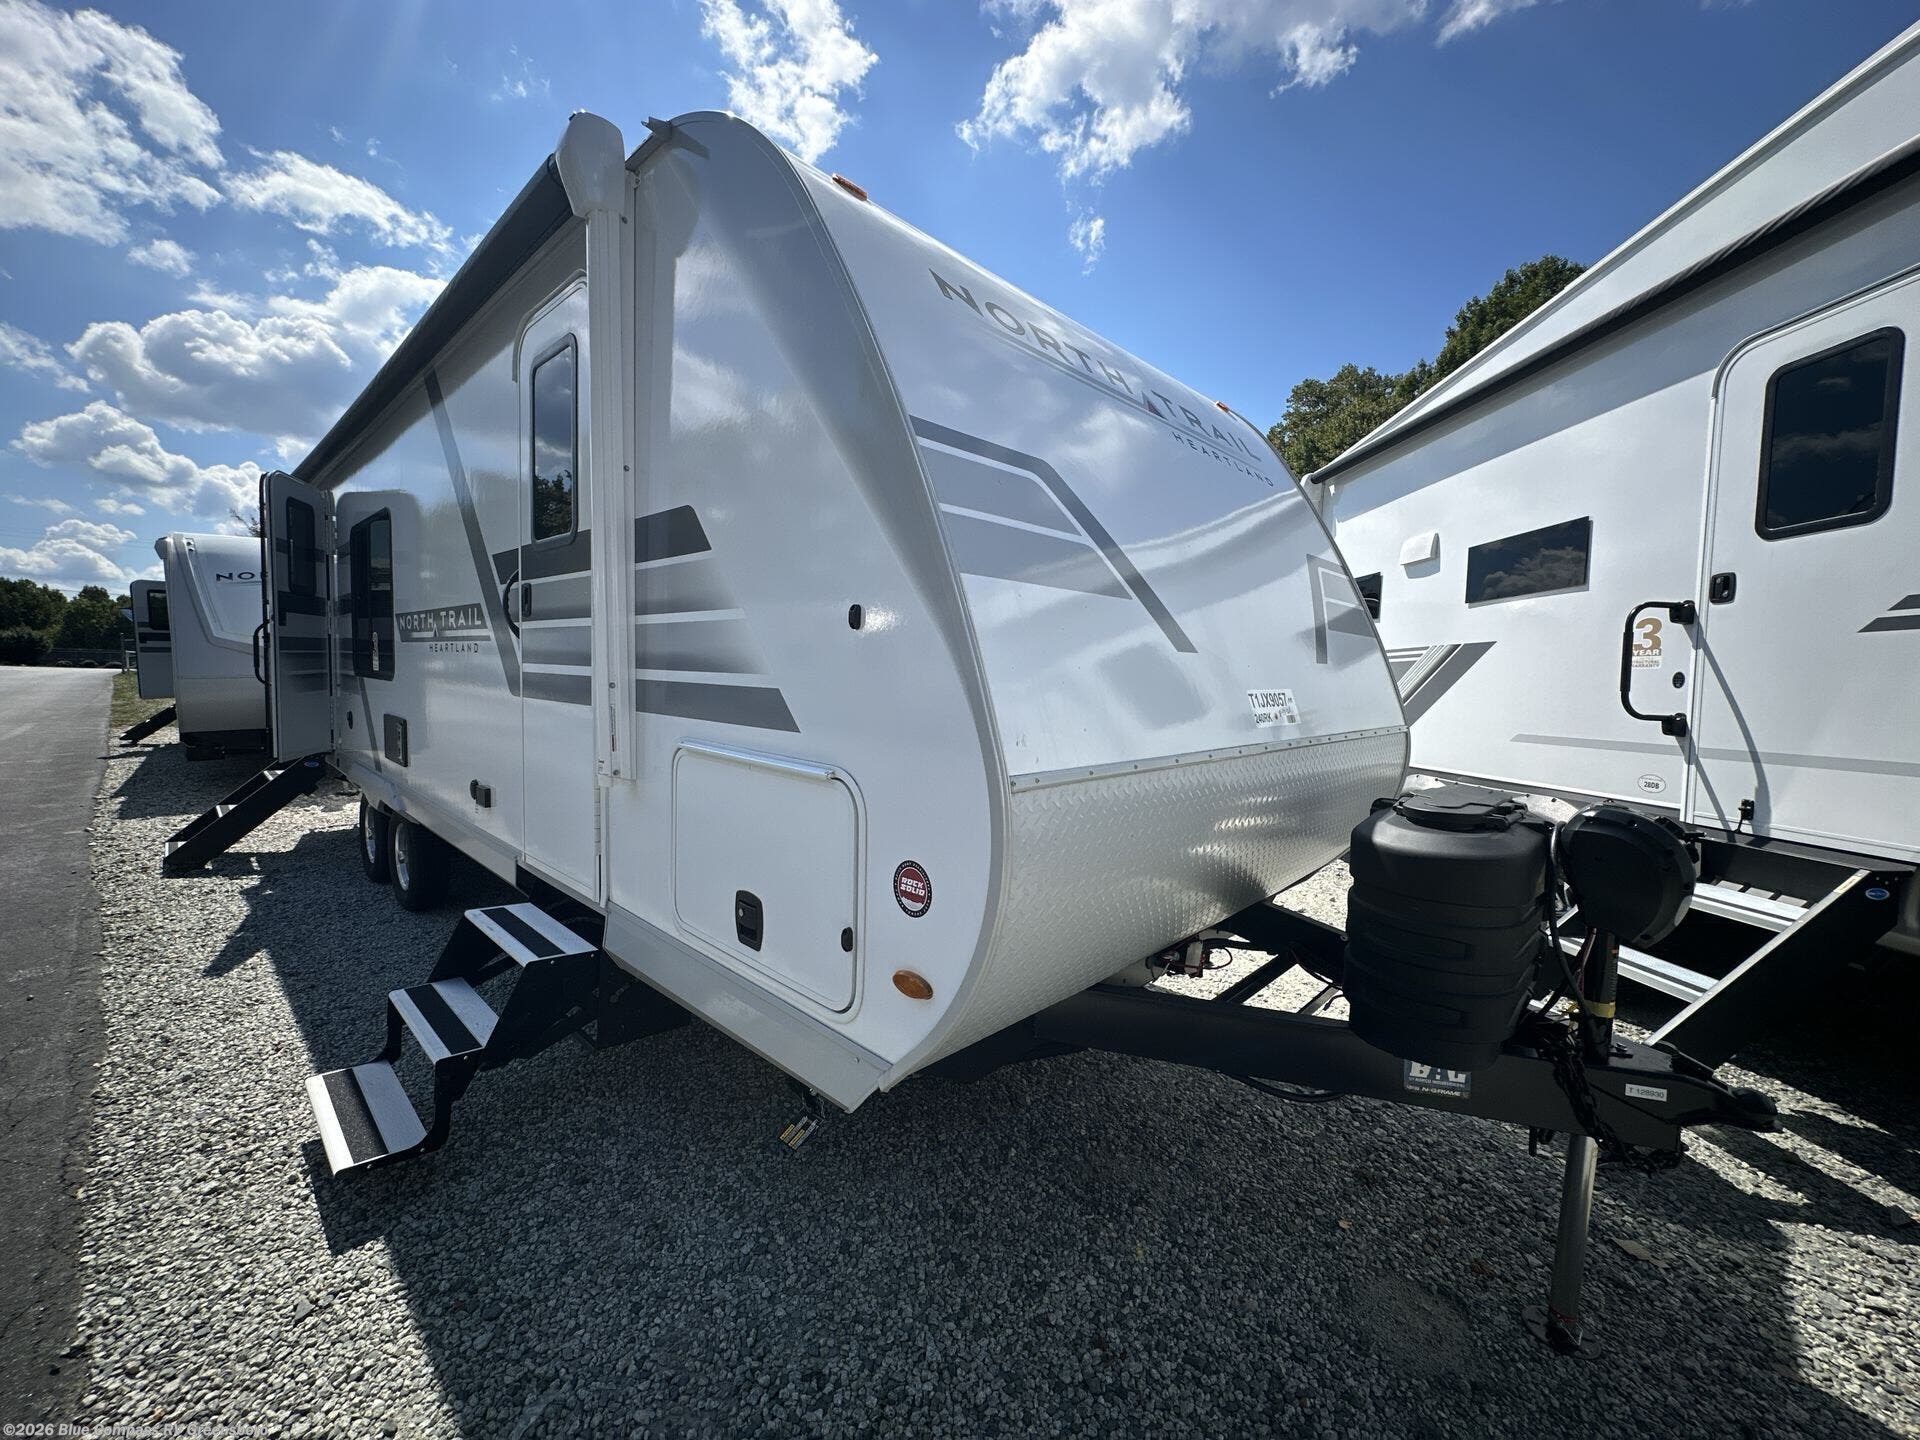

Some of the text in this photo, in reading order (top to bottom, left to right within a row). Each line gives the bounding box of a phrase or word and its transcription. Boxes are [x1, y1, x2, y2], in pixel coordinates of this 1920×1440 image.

[928, 268, 1263, 463] NORTH TRAIL
[1171, 431, 1275, 488] HEARTLAND
[399, 607, 482, 631] NORTH TRAIL
[1633, 617, 1663, 650] 3
[429, 643, 480, 654] HEARTLAND
[1248, 692, 1288, 709] T1JX9057
[900, 883, 926, 897] SOLID
[901, 876, 924, 889] ROCK
